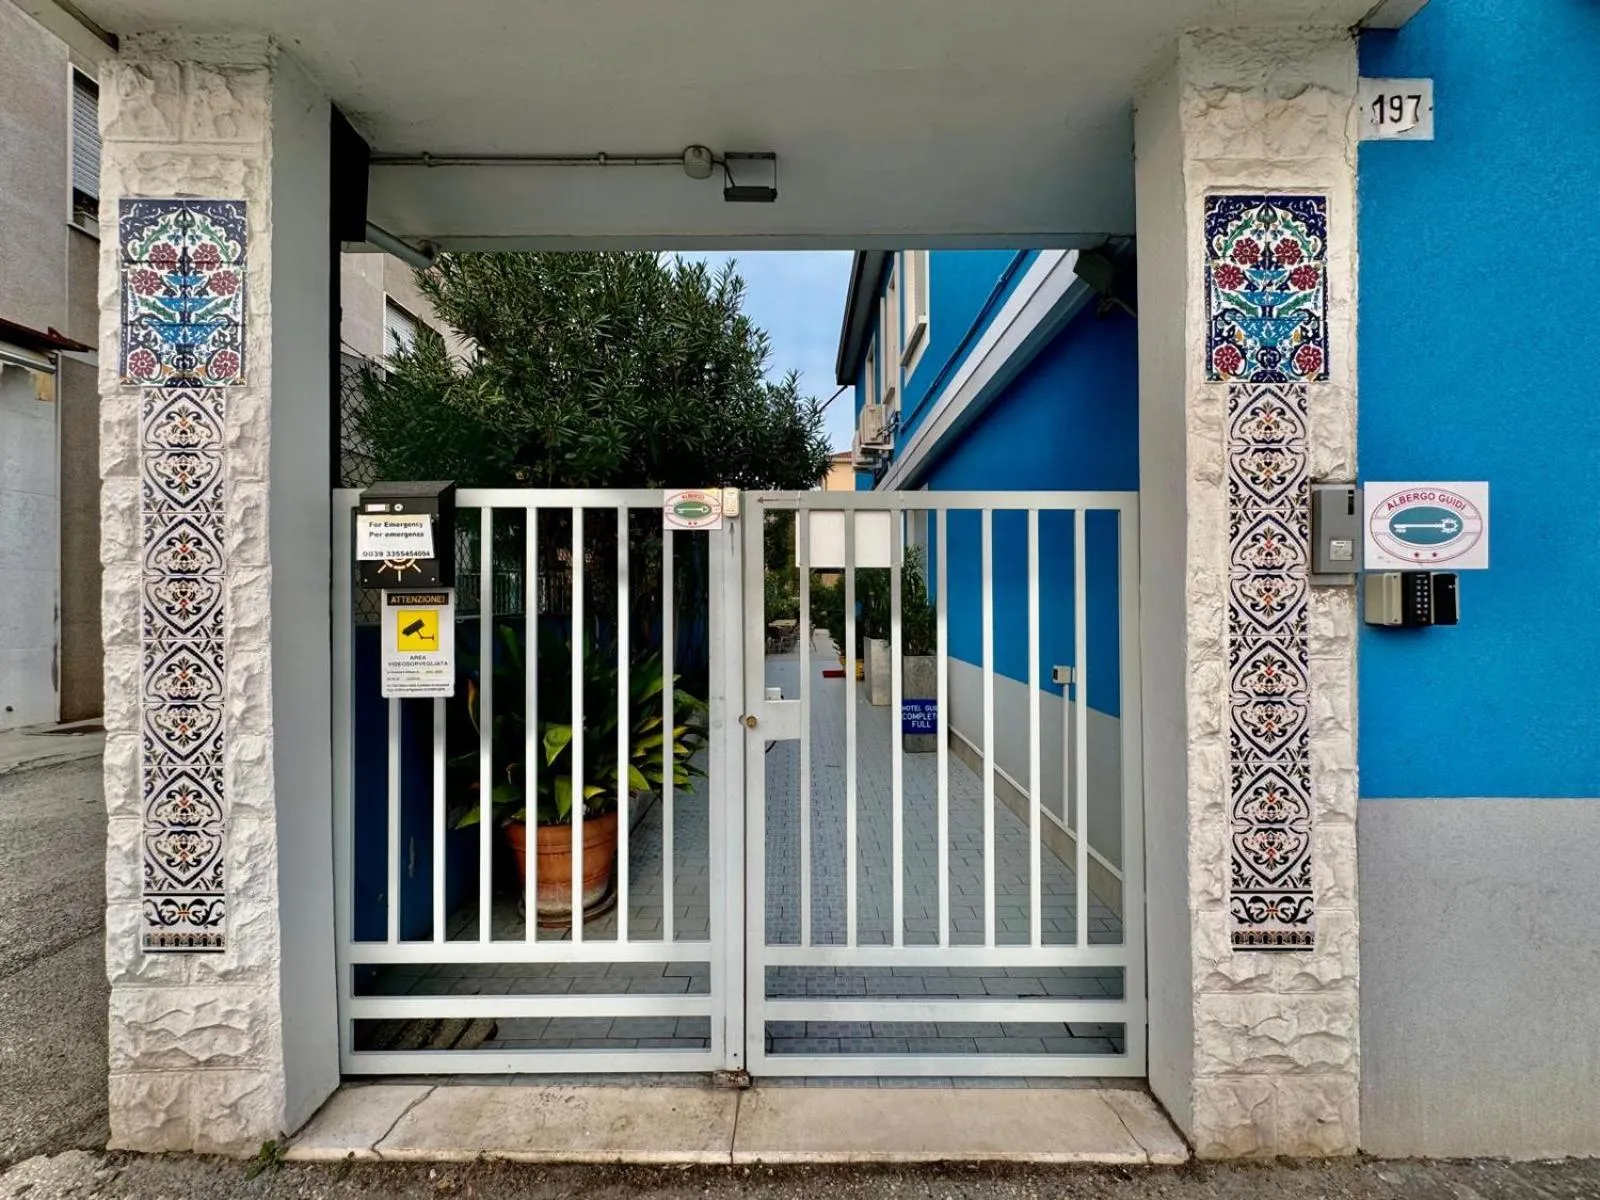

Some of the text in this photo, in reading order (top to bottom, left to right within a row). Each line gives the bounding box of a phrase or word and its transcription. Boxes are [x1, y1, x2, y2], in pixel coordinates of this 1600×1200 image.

[1371, 94, 1422, 125] 197
[1387, 492, 1467, 511] ALBERGO GUIDI
[384, 521, 423, 529] Emergency
[362, 550, 384, 558] 0039
[390, 595, 446, 604] ATTENZIONE!
[902, 712, 937, 720] COMPLET
[911, 720, 932, 729] FULL
